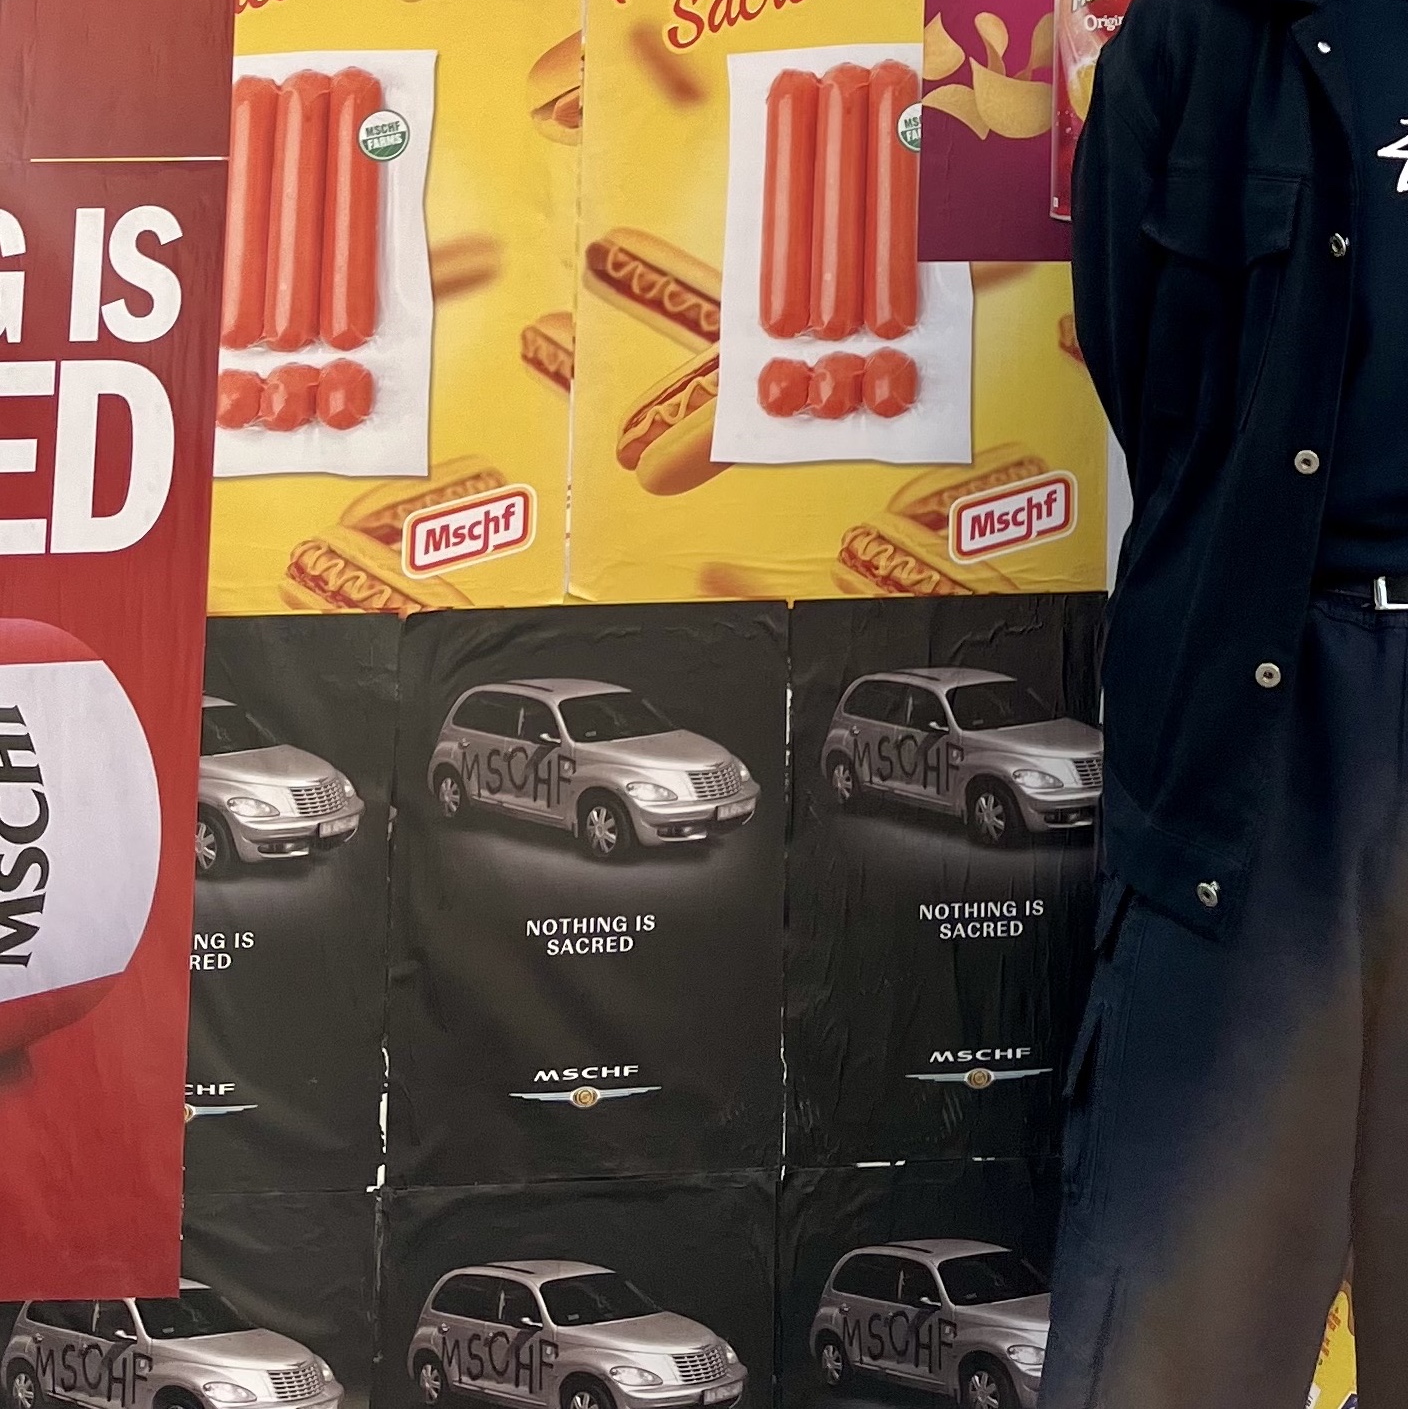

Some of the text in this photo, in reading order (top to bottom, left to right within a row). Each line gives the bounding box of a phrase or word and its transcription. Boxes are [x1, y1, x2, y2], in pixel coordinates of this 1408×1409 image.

[67, 205, 183, 343] IS
[969, 490, 1058, 542] Mschf
[424, 504, 519, 553] Mschf
[919, 899, 1045, 921] NOTHING IS
[526, 915, 656, 938] NOTHING IS
[939, 920, 1024, 940] SACRED
[234, 932, 255, 949] IS
[546, 935, 634, 955] SACRED
[930, 1047, 1032, 1064] MSCHF
[534, 1064, 640, 1082] MSCHF
